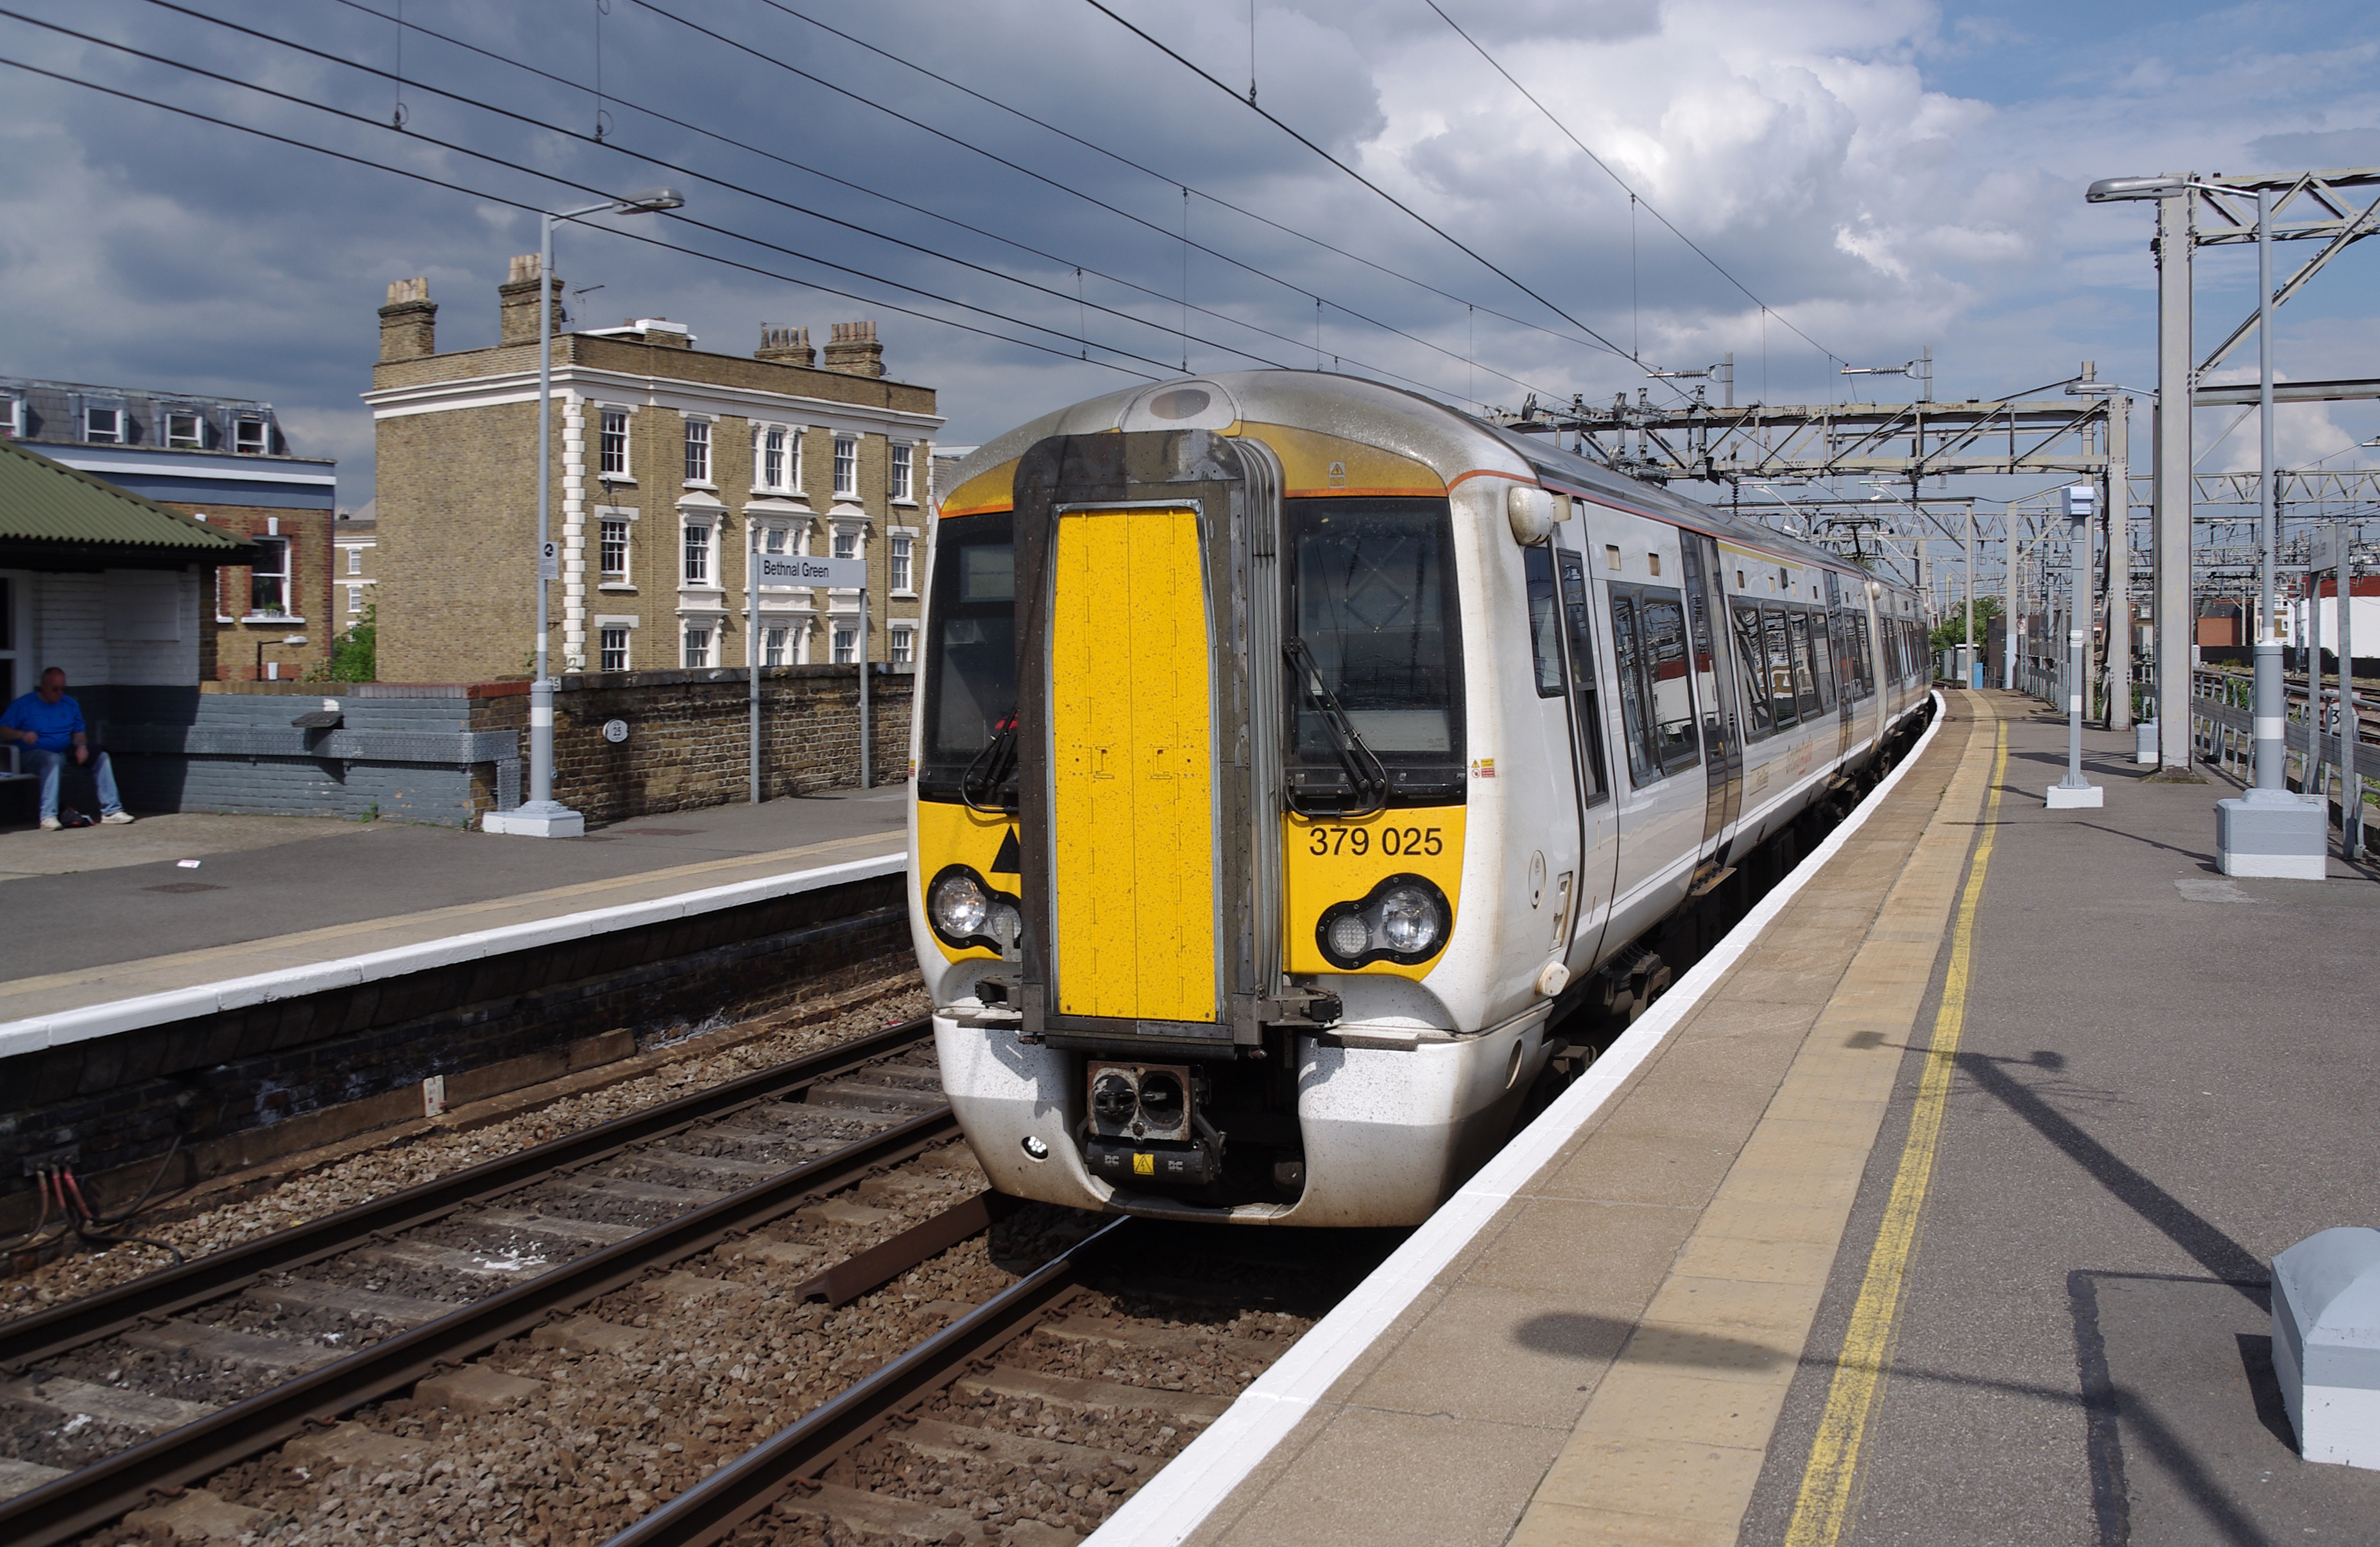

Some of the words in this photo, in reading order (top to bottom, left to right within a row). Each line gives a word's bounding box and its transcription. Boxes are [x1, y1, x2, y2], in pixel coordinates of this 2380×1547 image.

[764, 560, 800, 576] Bethnal
[802, 562, 829, 577] Green
[613, 726, 622, 736] 25
[1310, 827, 1369, 856] 379
[1382, 827, 1443, 856] 025
